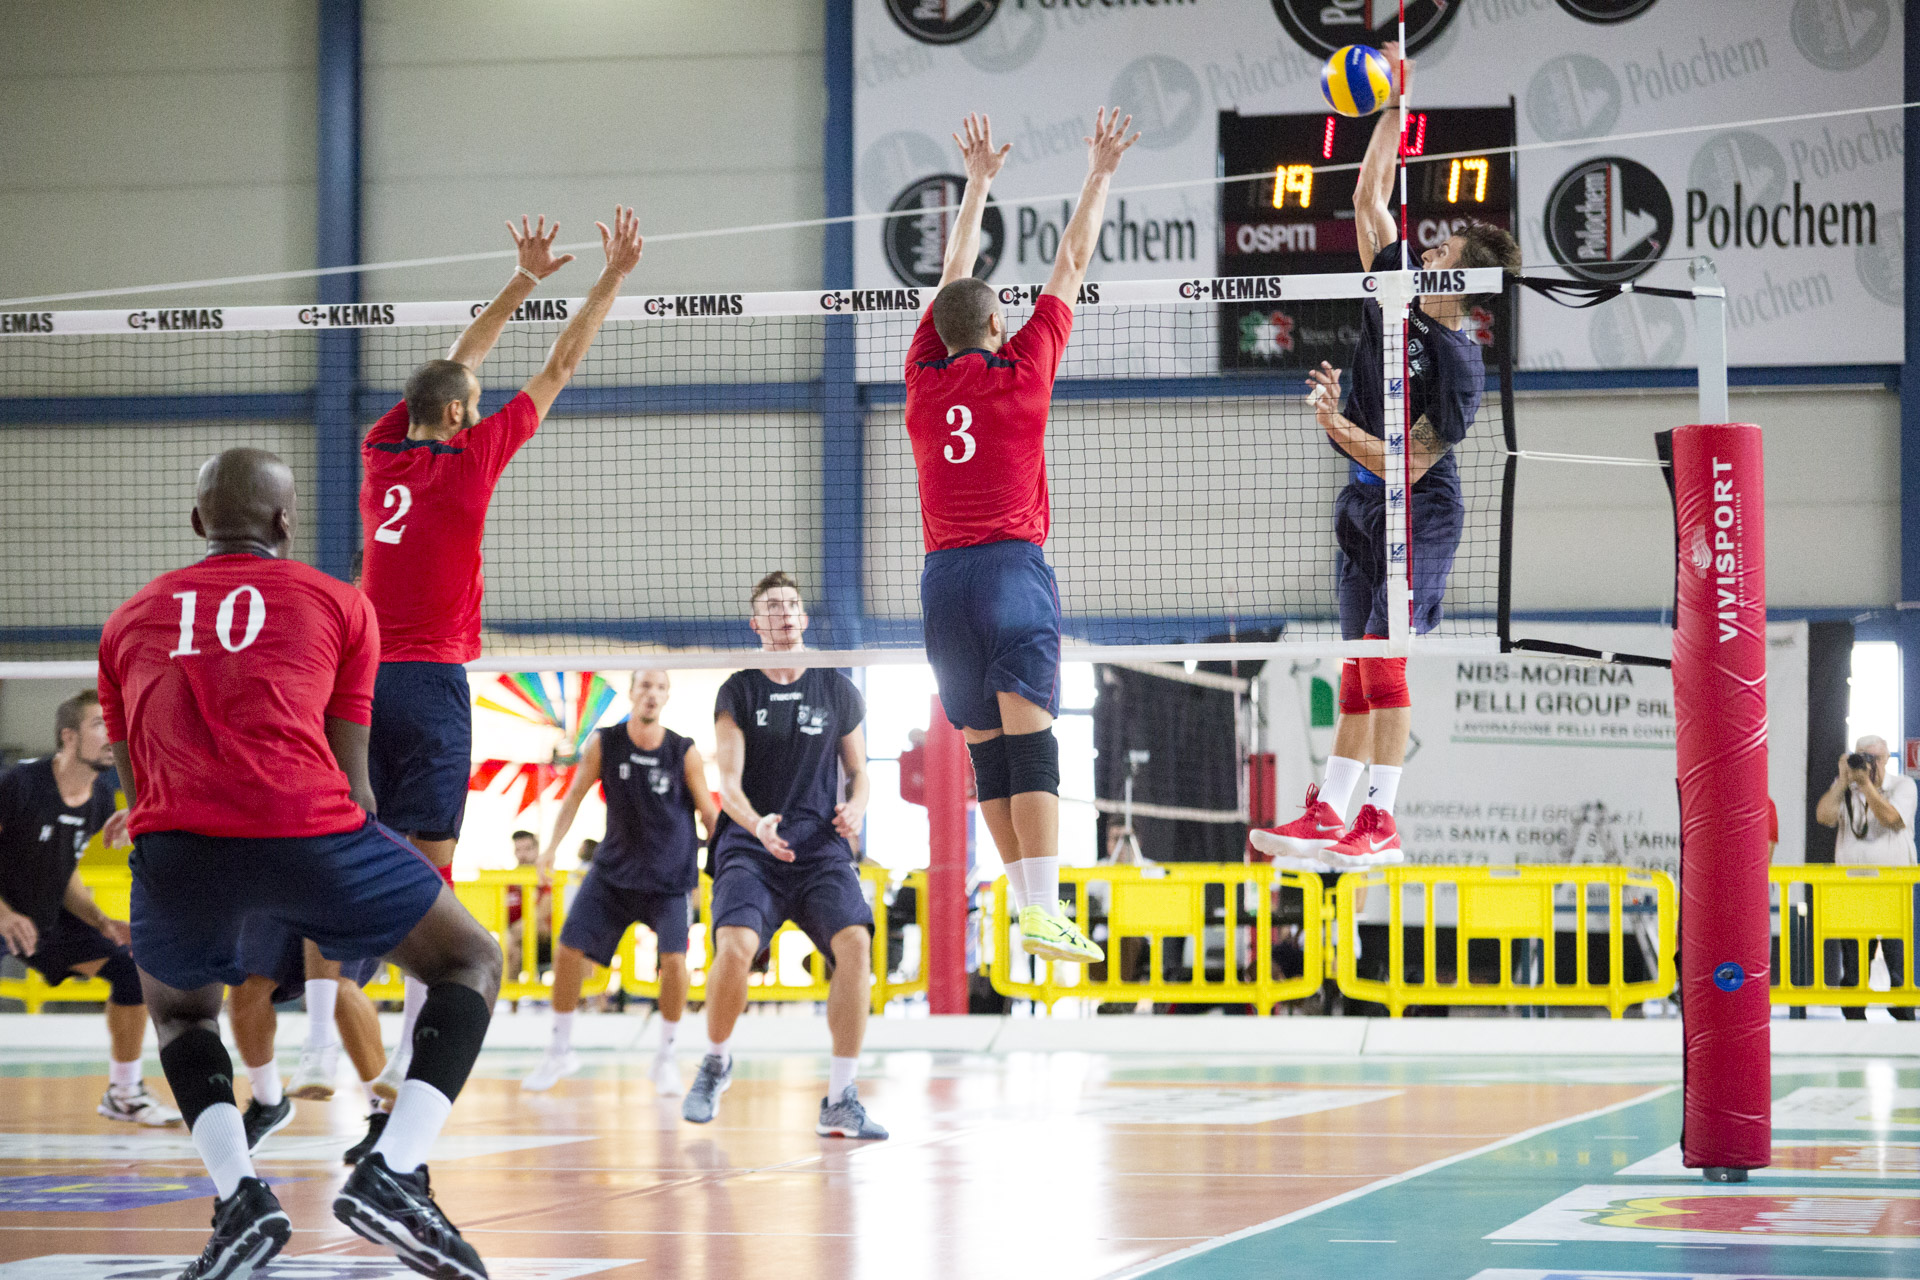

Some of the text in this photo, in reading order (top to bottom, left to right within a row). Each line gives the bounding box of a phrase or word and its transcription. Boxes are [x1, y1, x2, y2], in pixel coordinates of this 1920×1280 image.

[1202, 37, 1320, 108] Poloche
[1624, 37, 1770, 104] Polochem
[1790, 112, 1904, 183] Poloche
[1272, 158, 1489, 210] 19 17
[1686, 181, 1877, 250] Polochem
[1016, 199, 1198, 265] Polchem
[0, 270, 1466, 333] EMAS KEMAS KEMAS EMAS KEMAS KEMAS KAS KEMAS EMAS
[943, 404, 977, 464] 3
[374, 484, 412, 545] 2
[1712, 456, 1739, 644] VIVISPORT
[169, 585, 267, 659] 10
[1455, 690, 1527, 714] PELLI
[1535, 692, 1631, 716] GROUP
[1457, 662, 1634, 686] NBS-MORENA
[755, 708, 769, 727] 12
[1449, 827, 1510, 844] SANTA
[1516, 828, 1569, 846] CROC
